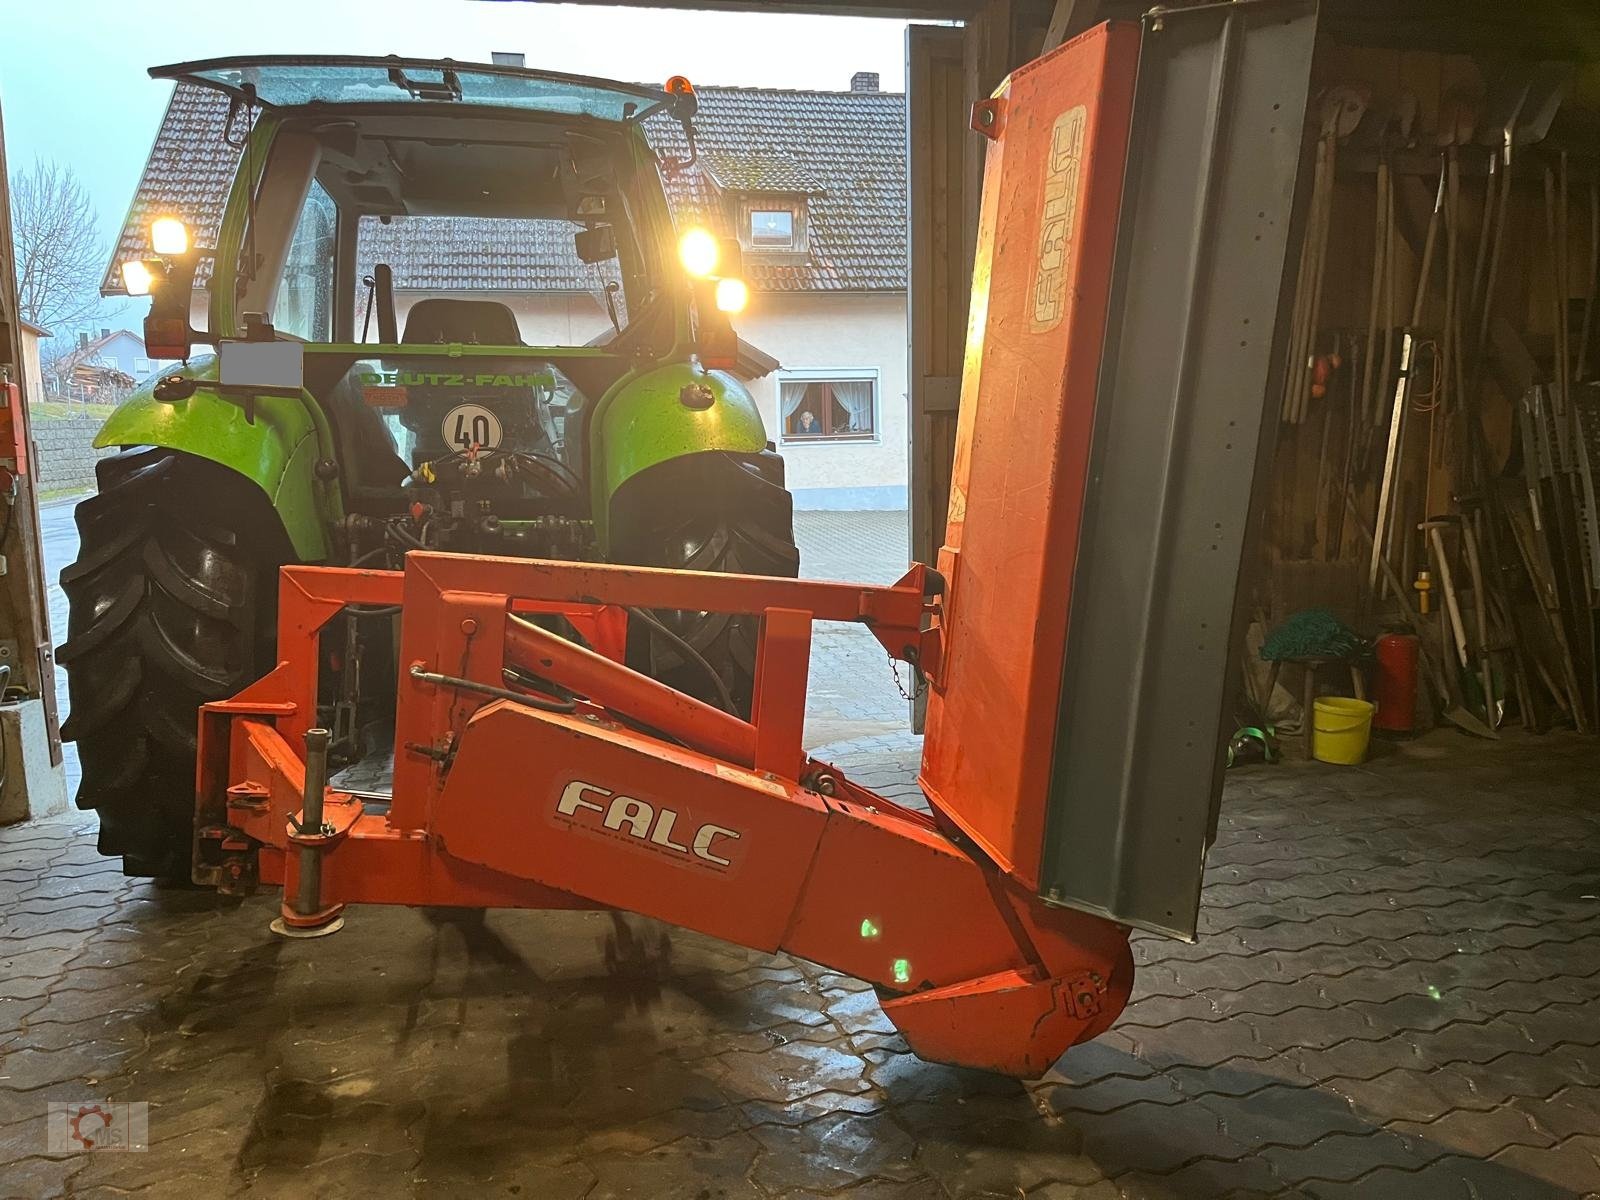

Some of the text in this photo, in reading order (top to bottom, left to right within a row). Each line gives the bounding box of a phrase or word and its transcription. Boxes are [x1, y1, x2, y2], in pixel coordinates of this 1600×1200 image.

[1034, 118, 1077, 322] FALC
[454, 415, 490, 448] 40
[556, 780, 741, 866] FALC
